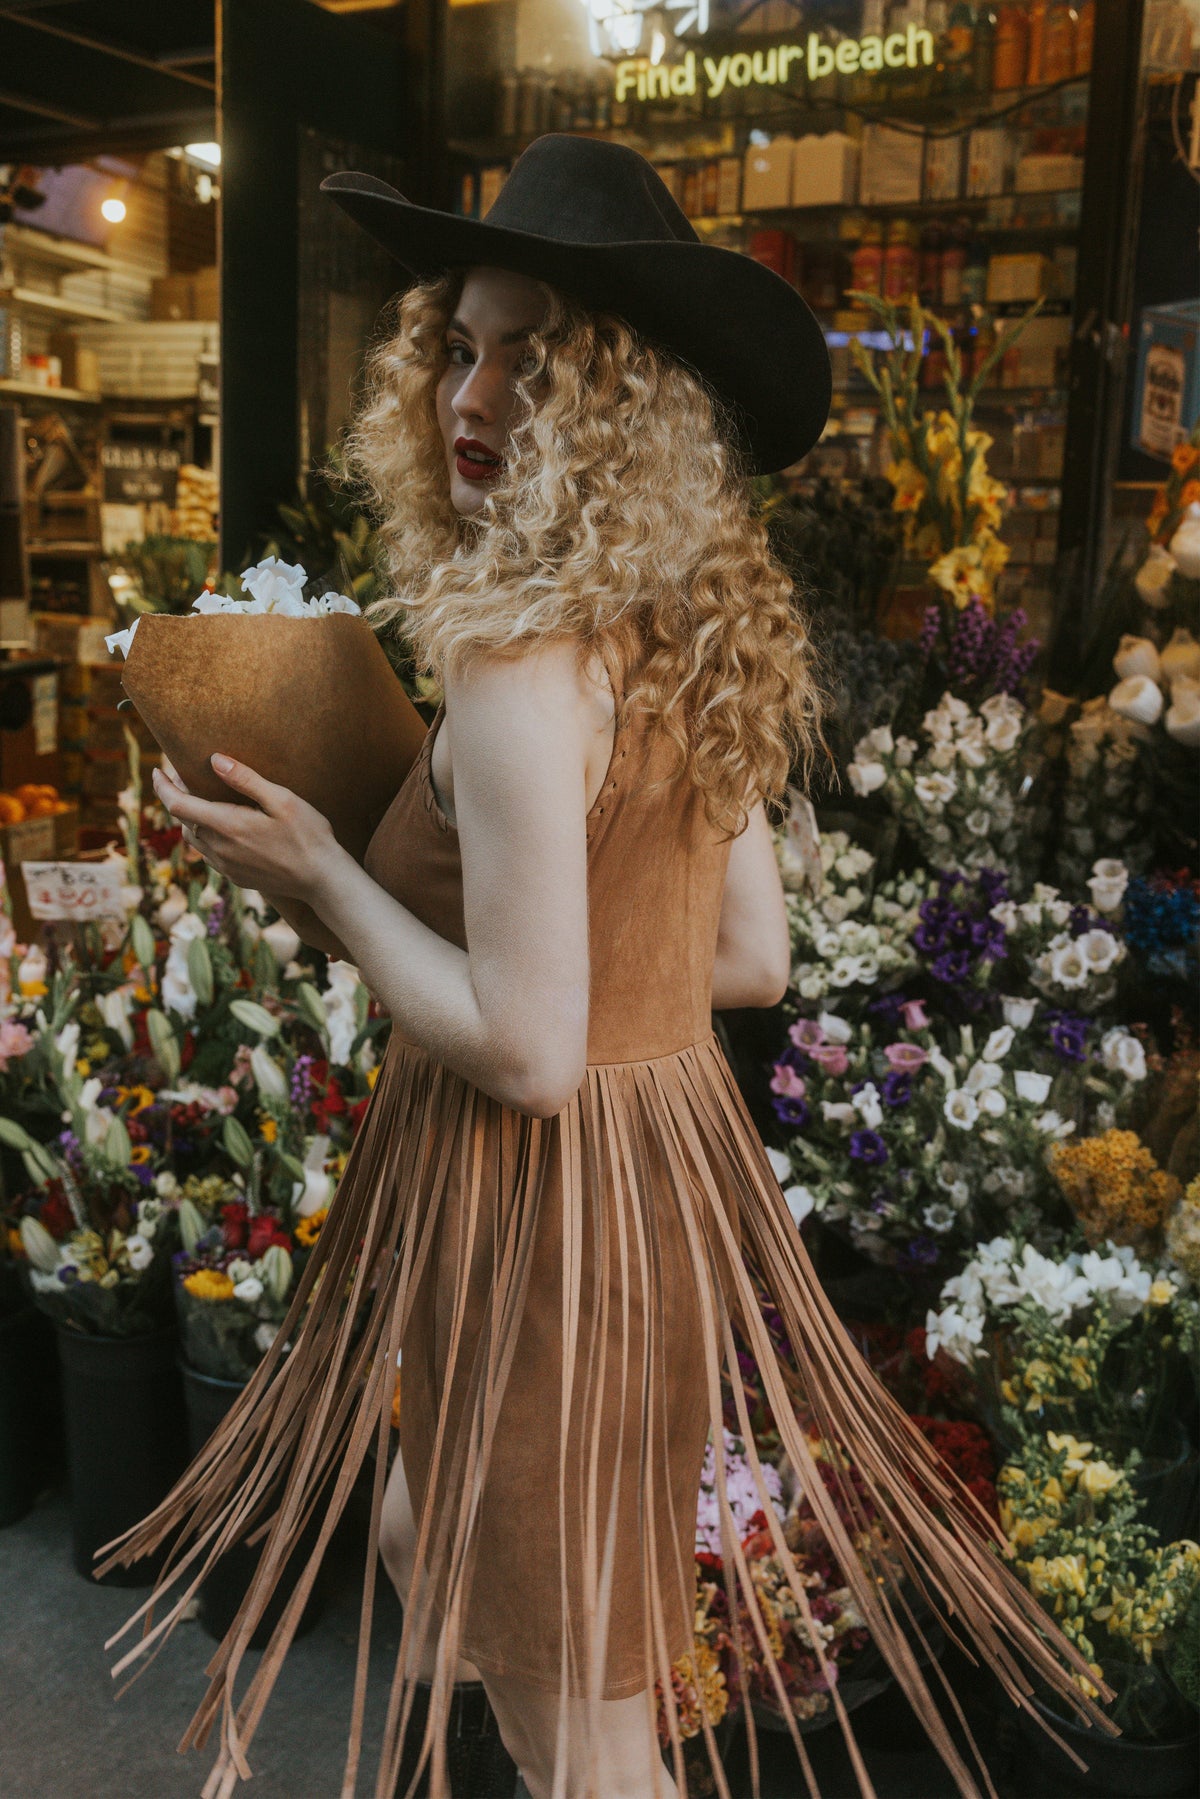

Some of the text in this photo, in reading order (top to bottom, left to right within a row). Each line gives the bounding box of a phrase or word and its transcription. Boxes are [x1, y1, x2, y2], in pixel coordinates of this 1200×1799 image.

[615, 22, 934, 103] Find your beach
